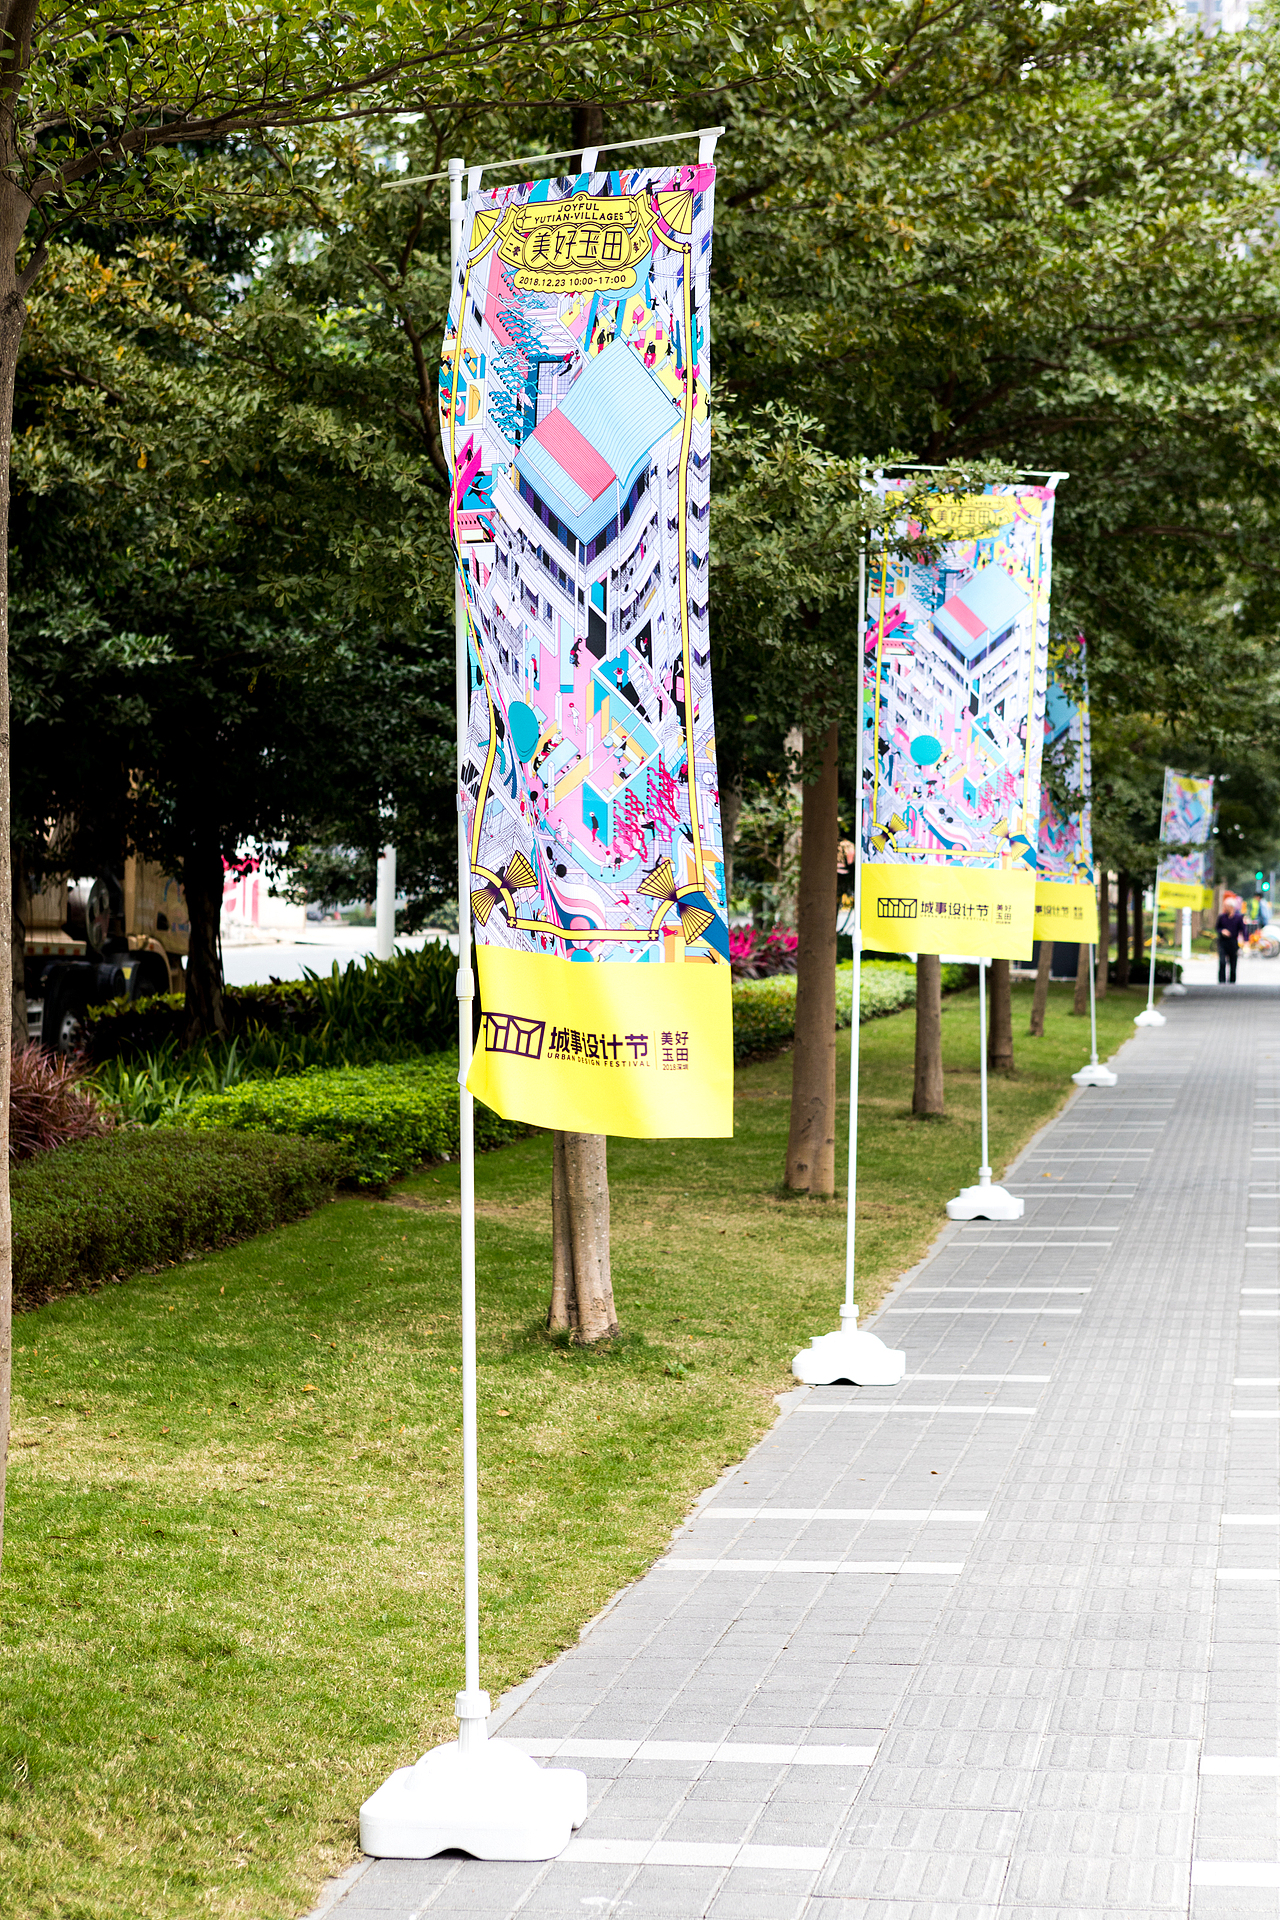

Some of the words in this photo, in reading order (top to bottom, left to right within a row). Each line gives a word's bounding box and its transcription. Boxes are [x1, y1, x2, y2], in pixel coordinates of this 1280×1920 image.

[557, 203, 600, 213] JOYFUL
[530, 230, 623, 263] 美好玉田
[518, 275, 566, 287] 2018.12.23
[569, 274, 627, 286] 10:00-17:00
[920, 900, 990, 917] 城事设计节
[548, 1026, 649, 1060] 城事设计节
[660, 1030, 690, 1046] 美好
[547, 1052, 577, 1062] URBAN
[577, 1055, 601, 1067] DESIGN
[603, 1060, 651, 1068] FESTIVAL
[661, 1047, 689, 1062] 玉田
